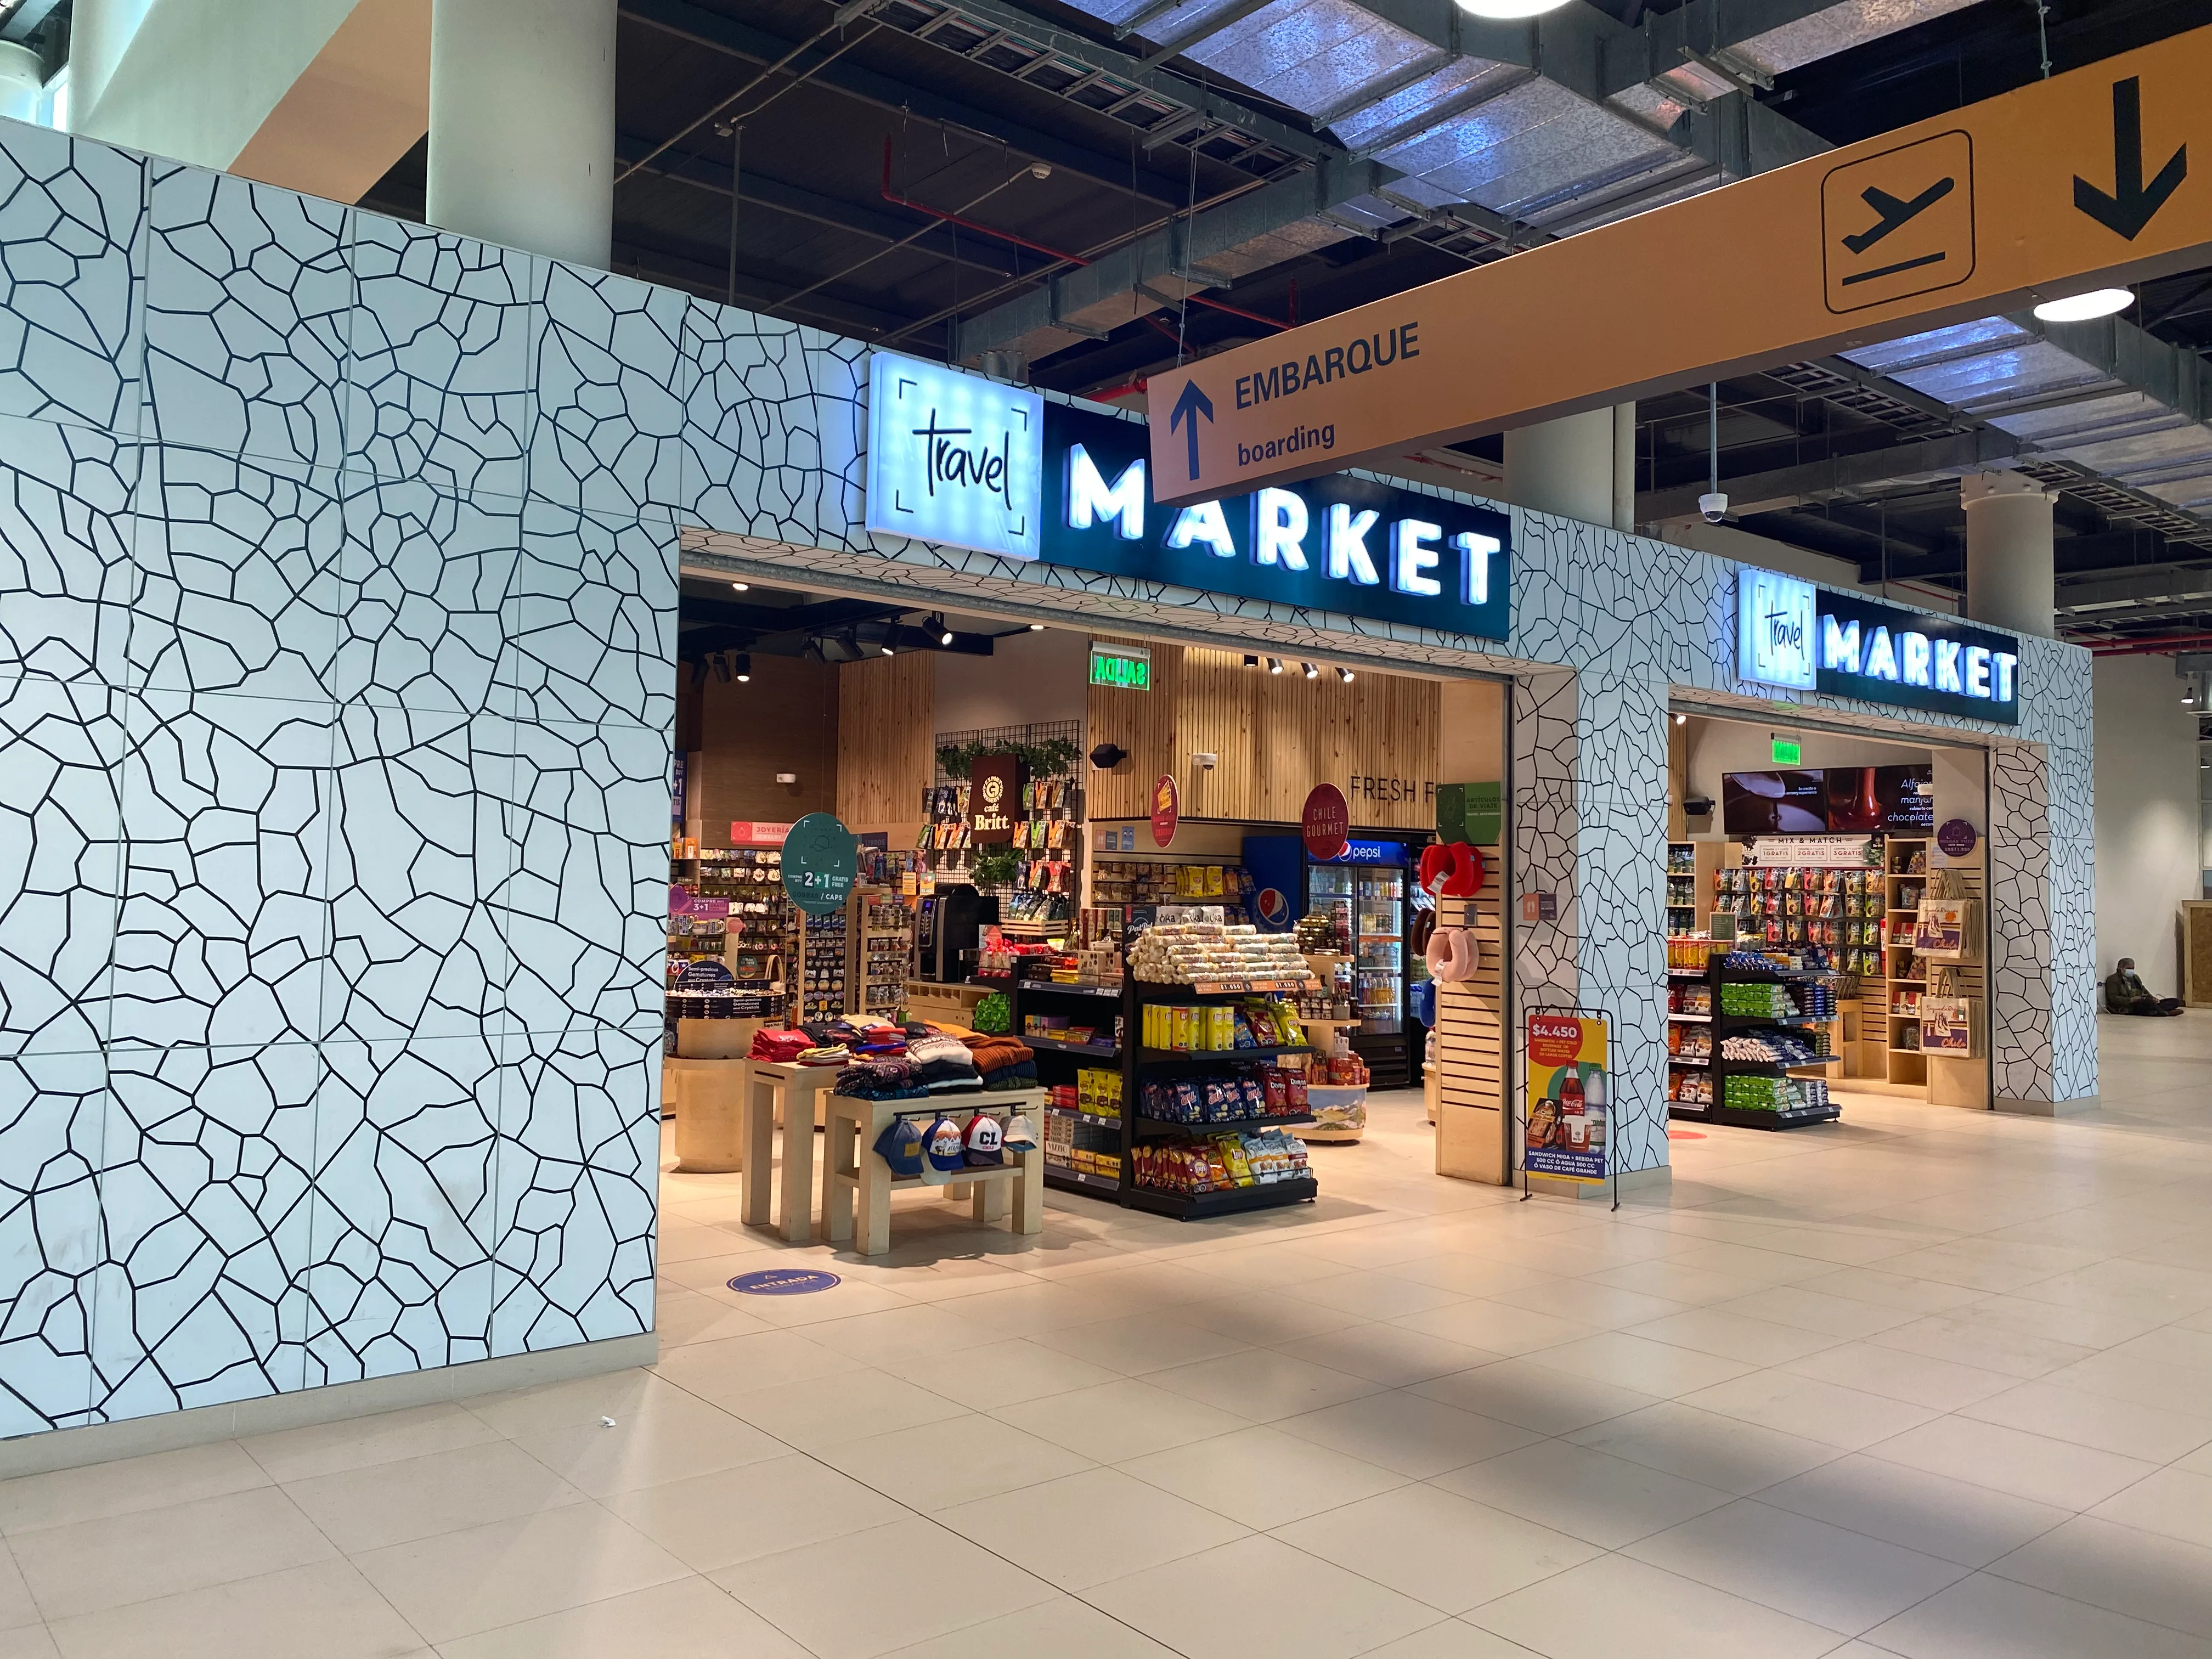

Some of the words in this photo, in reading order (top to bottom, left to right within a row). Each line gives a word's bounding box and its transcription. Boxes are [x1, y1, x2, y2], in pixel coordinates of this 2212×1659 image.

[1235, 321, 1419, 409] EMBARQUE
[1238, 424, 1335, 466] boarding
[1064, 443, 1500, 605] MARKET
[1820, 614, 2017, 702] MARKET
[674, 759, 684, 769] PRE
[673, 778, 682, 795] +1
[1351, 776, 1417, 802] FRESH
[984, 803, 999, 812] café
[1313, 806, 1336, 821] CHILE
[1887, 811, 1933, 821] chocolate
[756, 825, 789, 833] JOYERÍA
[1307, 822, 1344, 838] GOURMET
[1353, 846, 1381, 860] pepsi
[1159, 913, 1176, 923] tika
[1209, 913, 1222, 923] tika
[1532, 1023, 1577, 1038] $4.450
[979, 1131, 998, 1145] CL
[1194, 1165, 1207, 1175] Lay's
[749, 1274, 819, 1290] ENTRADA
